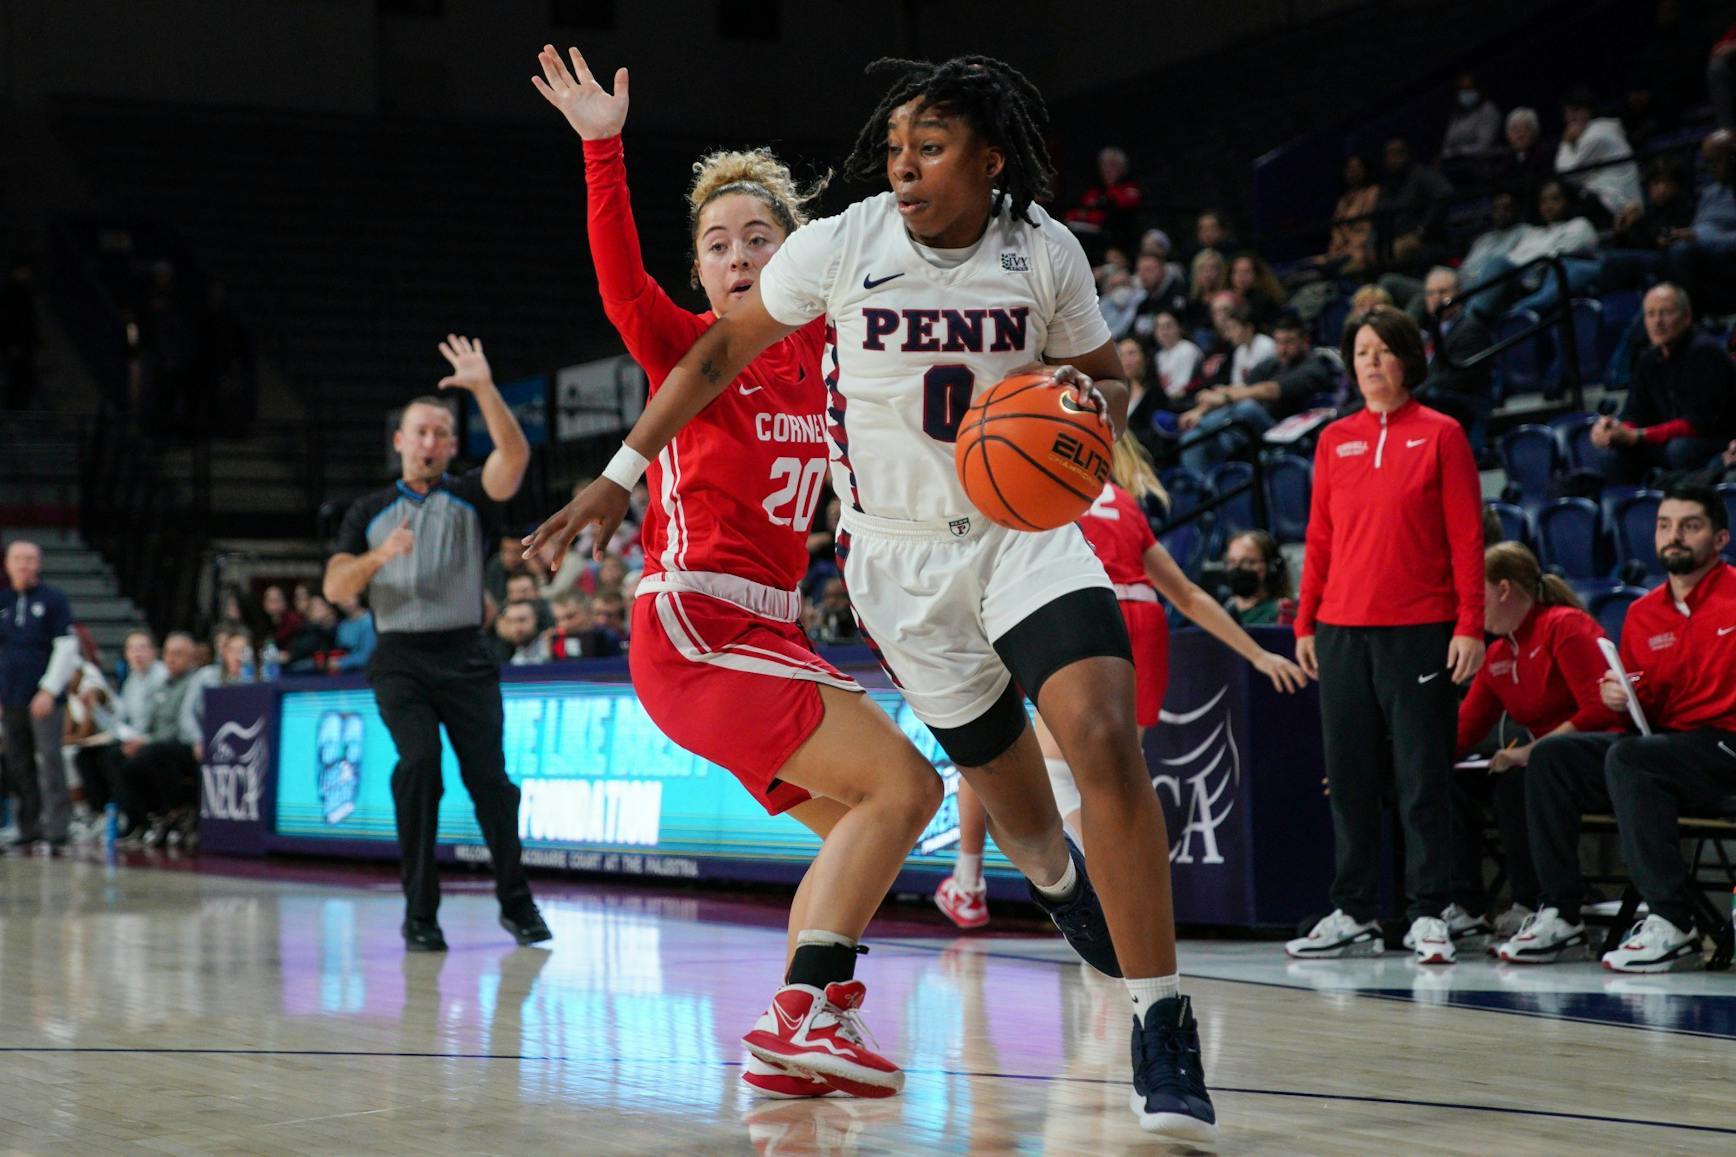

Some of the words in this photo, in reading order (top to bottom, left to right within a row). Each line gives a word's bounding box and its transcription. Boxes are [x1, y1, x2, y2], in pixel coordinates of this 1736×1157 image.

[1009, 256, 1028, 266] IVY
[862, 307, 1030, 352] PENN
[923, 364, 975, 443] 0
[756, 412, 829, 443] CORNEL
[1052, 431, 1110, 485] ELITE
[762, 457, 827, 531] 20
[1083, 482, 1120, 520] 2
